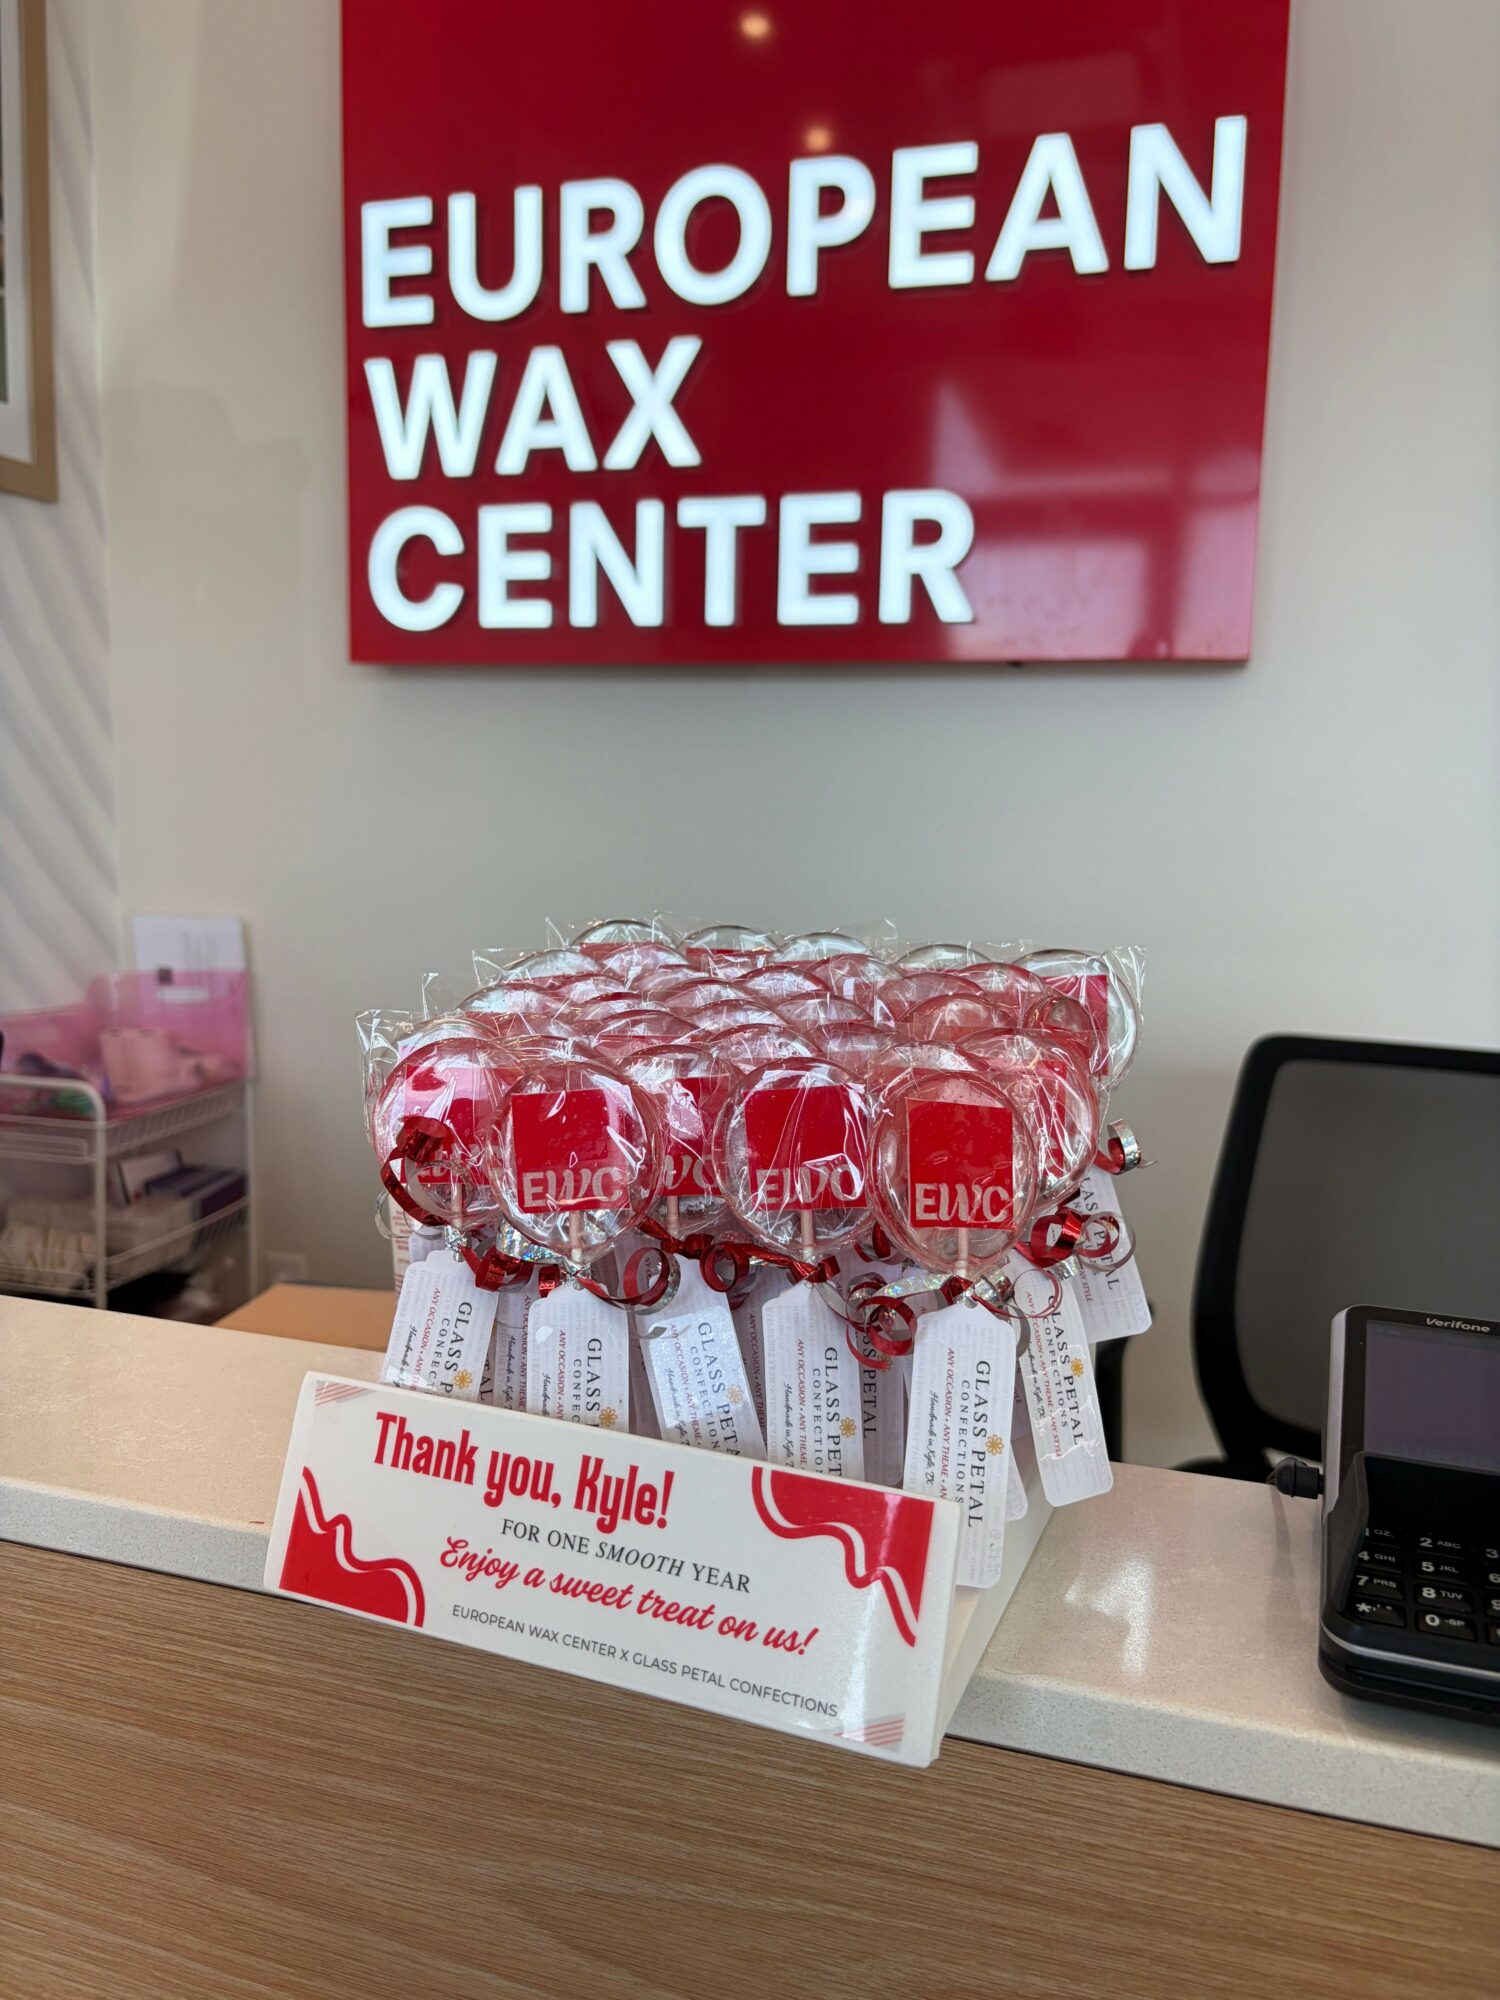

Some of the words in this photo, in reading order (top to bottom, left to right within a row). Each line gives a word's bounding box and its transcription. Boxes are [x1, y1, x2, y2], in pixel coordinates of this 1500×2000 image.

[361, 115, 1247, 328] EUROPEAN
[363, 335, 703, 480] WAX
[367, 489, 976, 632] CENTER
[522, 1165, 622, 1208] EWC
[915, 1182, 1010, 1223] EWC
[749, 1313, 757, 1331] ANY
[1026, 1291, 1035, 1309] ANY
[421, 1306, 437, 1350] OCCASION
[443, 1301, 473, 1372] GLASS
[559, 1330, 567, 1351] ANY
[669, 1323, 680, 1341] ANY
[1426, 1317, 1491, 1333] Verifone
[674, 1341, 689, 1387] OCCASION
[751, 1331, 760, 1375] OCCASION
[796, 1339, 805, 1358] ANY
[947, 1347, 955, 1368] ANY
[519, 1374, 527, 1407] THEME
[557, 1351, 566, 1396] OCCASION
[572, 1358, 582, 1423] CONFEC
[586, 1338, 603, 1412] GLASS
[698, 1321, 726, 1394] GLASS
[717, 1403, 740, 1456] PETA
[797, 1358, 807, 1405] OCCASION
[824, 1347, 840, 1422] GLASS
[944, 1368, 954, 1418] OCCASION
[1042, 1316, 1068, 1428] CONFECTIONS
[686, 1391, 696, 1411] ANY
[690, 1345, 720, 1449] CONFECTION
[783, 1382, 793, 1432] Handmade
[863, 1369, 877, 1439] PETAL
[927, 1390, 939, 1438] Handmade
[972, 1360, 991, 1438] GLASS
[1064, 1375, 1084, 1445] PETAL
[690, 1411, 702, 1441] THEME
[943, 1423, 951, 1442] ANY
[955, 1380, 970, 1504] CONFECTIONS
[1049, 1415, 1058, 1432] ANY
[1052, 1432, 1062, 1458] STYLE
[799, 1431, 808, 1465] THEME
[940, 1441, 950, 1480] THEME
[373, 1411, 479, 1485] Thank
[482, 1449, 562, 1508] you,
[576, 1454, 676, 1534] Kyle!
[940, 1484, 948, 1499] AN
[967, 1450, 986, 1528] PETAL
[501, 1518, 542, 1545] FOR
[546, 1530, 591, 1556] ONE
[594, 1540, 687, 1579] SMOOTH
[691, 1562, 752, 1594] YEAR
[1358, 1550, 1370, 1561] 4
[1374, 1553, 1395, 1562] GHI
[1419, 1537, 1433, 1548] 2
[1437, 1540, 1461, 1549] ABC
[1485, 1548, 1499, 1559] 3
[1356, 1574, 1369, 1586] 7
[1373, 1578, 1397, 1588] PRS
[1421, 1561, 1435, 1572] 5
[1439, 1565, 1459, 1573] JKL
[1488, 1573, 1500, 1584] 6
[440, 1536, 521, 1591] Enjoy
[522, 1568, 547, 1589] a
[549, 1573, 632, 1609] sweet
[637, 1587, 714, 1627] treat
[717, 1613, 760, 1638] on
[763, 1627, 821, 1656] us!
[1422, 1587, 1436, 1599] 8
[1440, 1590, 1462, 1600] TUV
[1425, 1613, 1440, 1627] 0
[451, 1604, 527, 1635] EUROPEAN
[528, 1622, 560, 1644] WAX
[562, 1630, 617, 1659] CENTER
[617, 1645, 630, 1661] X
[631, 1651, 678, 1677] GLASS
[680, 1664, 726, 1692] PETAL
[729, 1675, 839, 1718] CONFECTIONS
